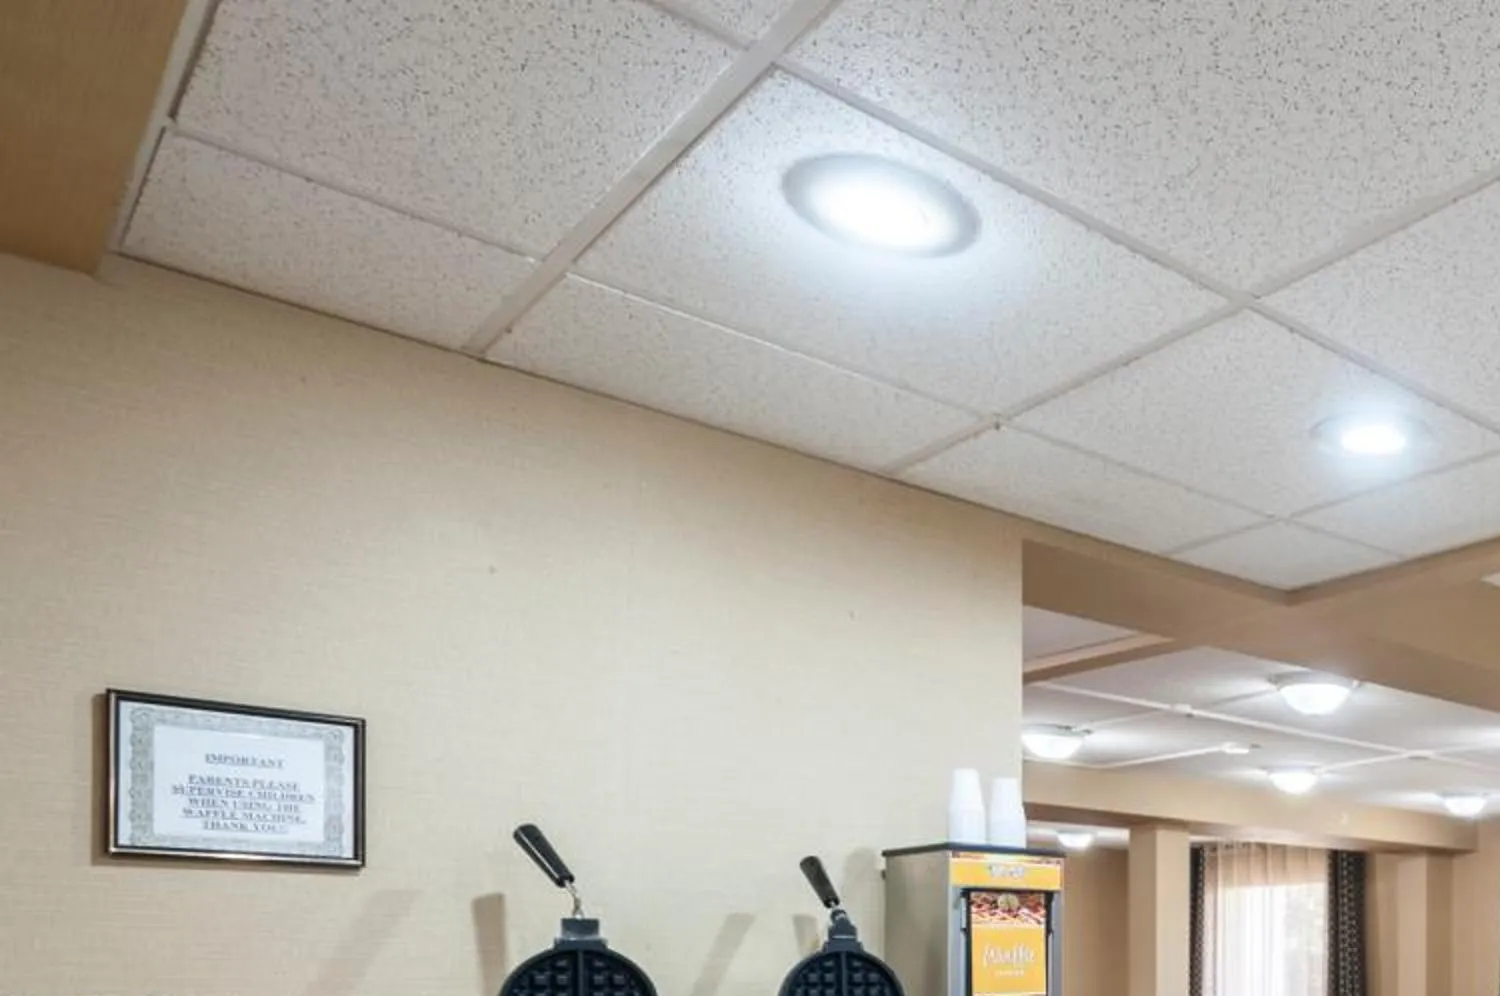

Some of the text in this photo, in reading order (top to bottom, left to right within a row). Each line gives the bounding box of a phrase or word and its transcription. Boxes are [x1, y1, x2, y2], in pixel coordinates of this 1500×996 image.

[205, 753, 285, 769] IMPORTANT
[188, 773, 298, 791] PARENTS PLEASE
[171, 784, 243, 798] SUPERVISE
[188, 797, 229, 808] WHEN
[277, 803, 300, 813] THE
[181, 807, 239, 820] WAFFLE
[203, 820, 249, 832] THANK
